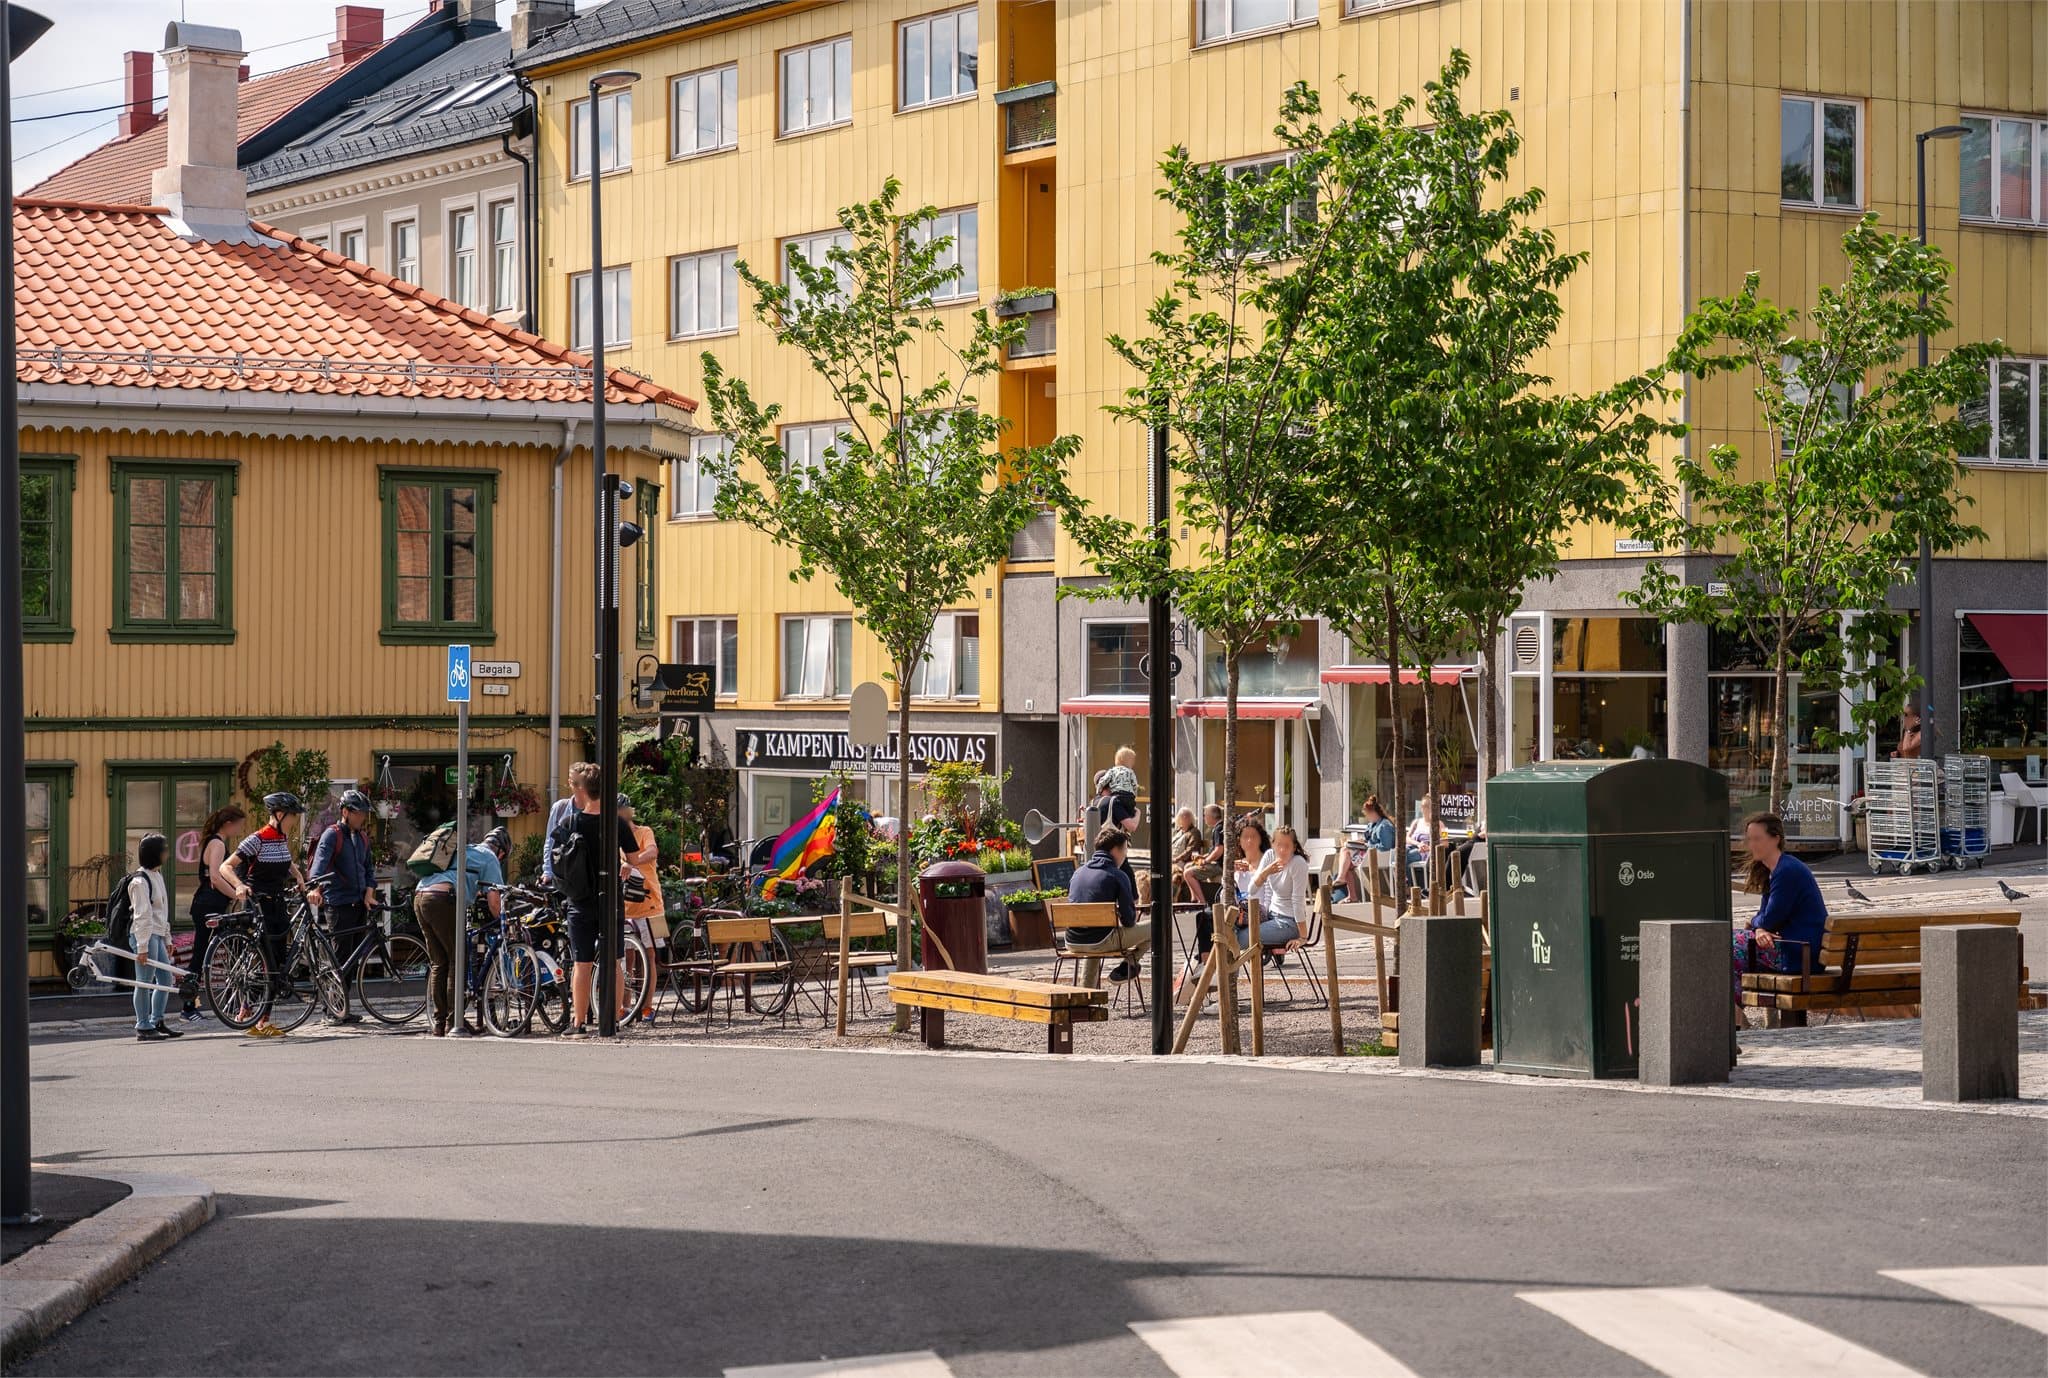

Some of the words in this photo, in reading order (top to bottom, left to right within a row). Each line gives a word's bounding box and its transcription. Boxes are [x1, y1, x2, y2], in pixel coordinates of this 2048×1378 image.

[479, 664, 512, 676] Bøgata
[765, 733, 833, 757] KAMPEN
[963, 737, 986, 762] AS
[1441, 794, 1475, 807] KAMPEN
[1780, 799, 1832, 812] KAMPEN
[1441, 807, 1457, 817] KAFFE
[1458, 808, 1463, 817] &
[1464, 808, 1475, 817] BAR
[1781, 813, 1803, 822] AFFE
[1806, 813, 1812, 822] &
[1816, 813, 1832, 822] BAR
[1521, 873, 1536, 883] Oslo
[1637, 870, 1655, 880] Oslo
